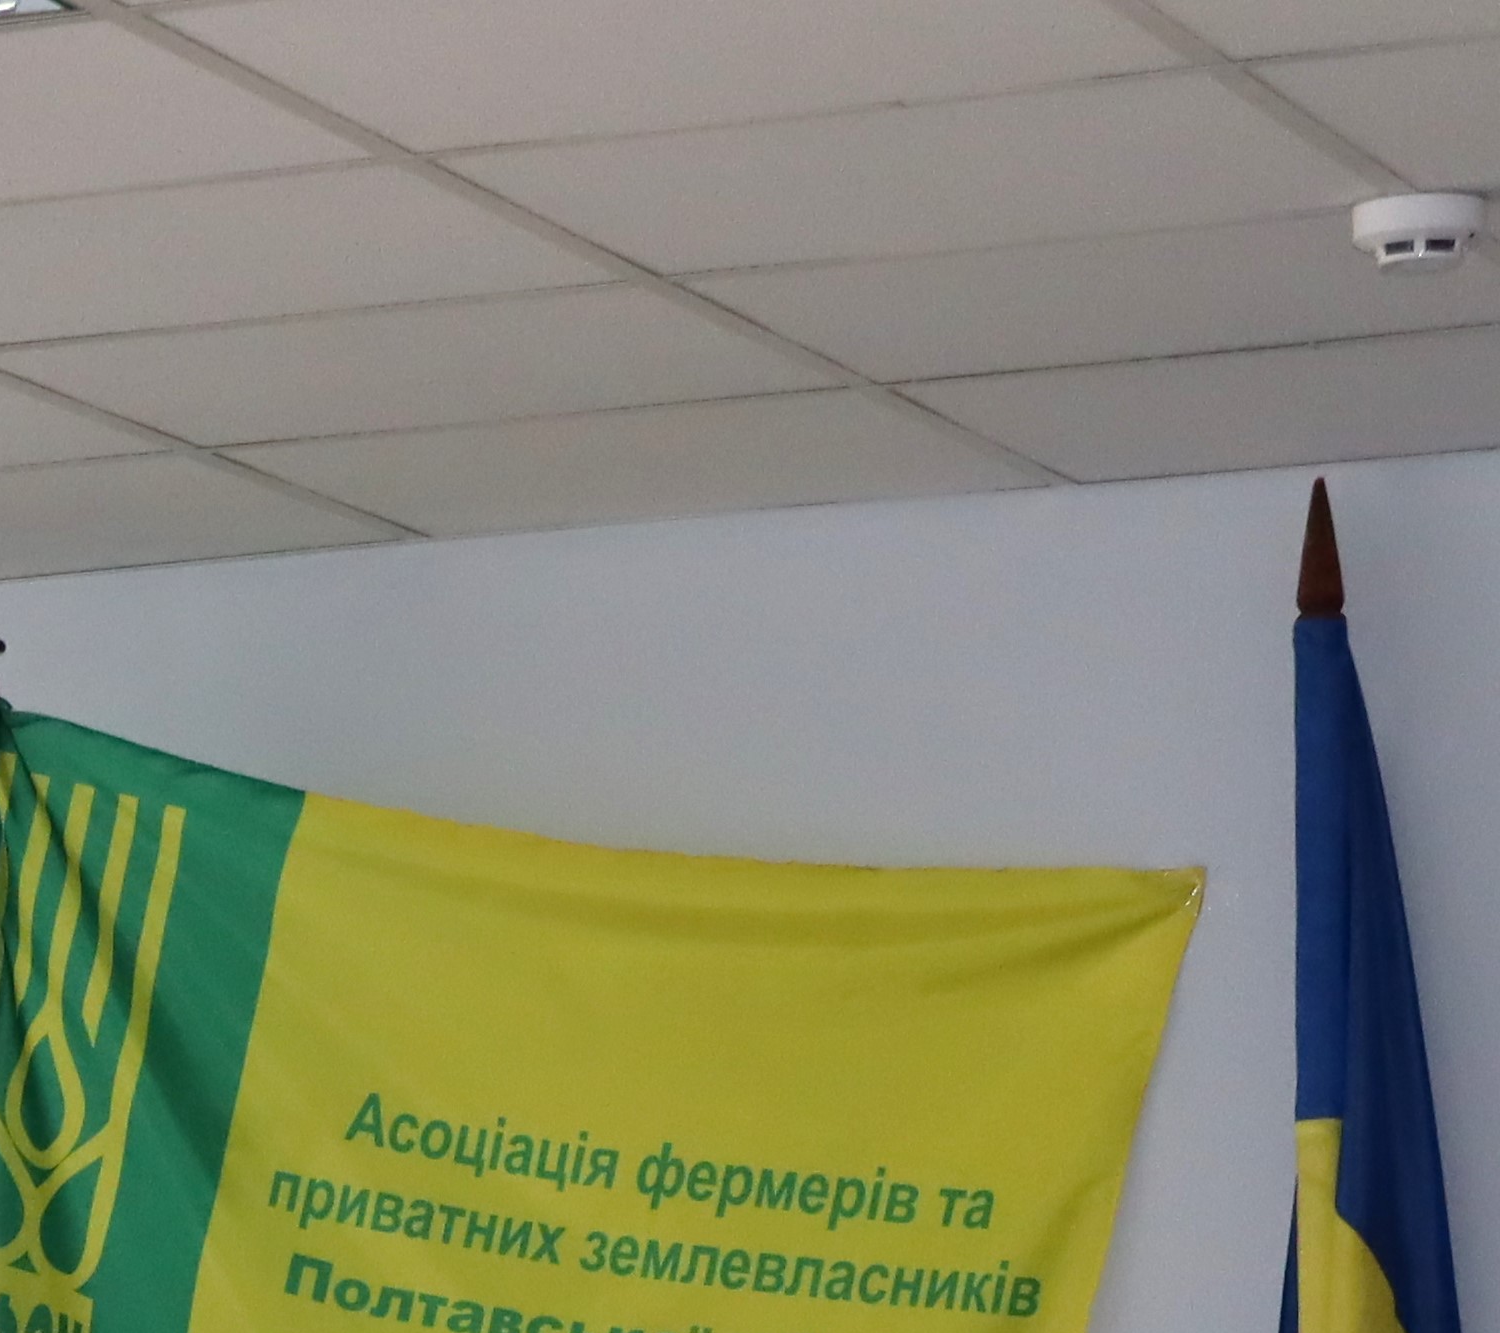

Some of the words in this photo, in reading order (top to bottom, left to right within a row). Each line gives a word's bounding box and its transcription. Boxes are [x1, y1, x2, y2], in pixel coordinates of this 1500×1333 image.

[344, 1092, 620, 1192] Асоціація
[636, 1142, 921, 1231] фермерів
[938, 1187, 995, 1230] та
[267, 1170, 566, 1265] приватних
[578, 1230, 1042, 1318] землевласників
